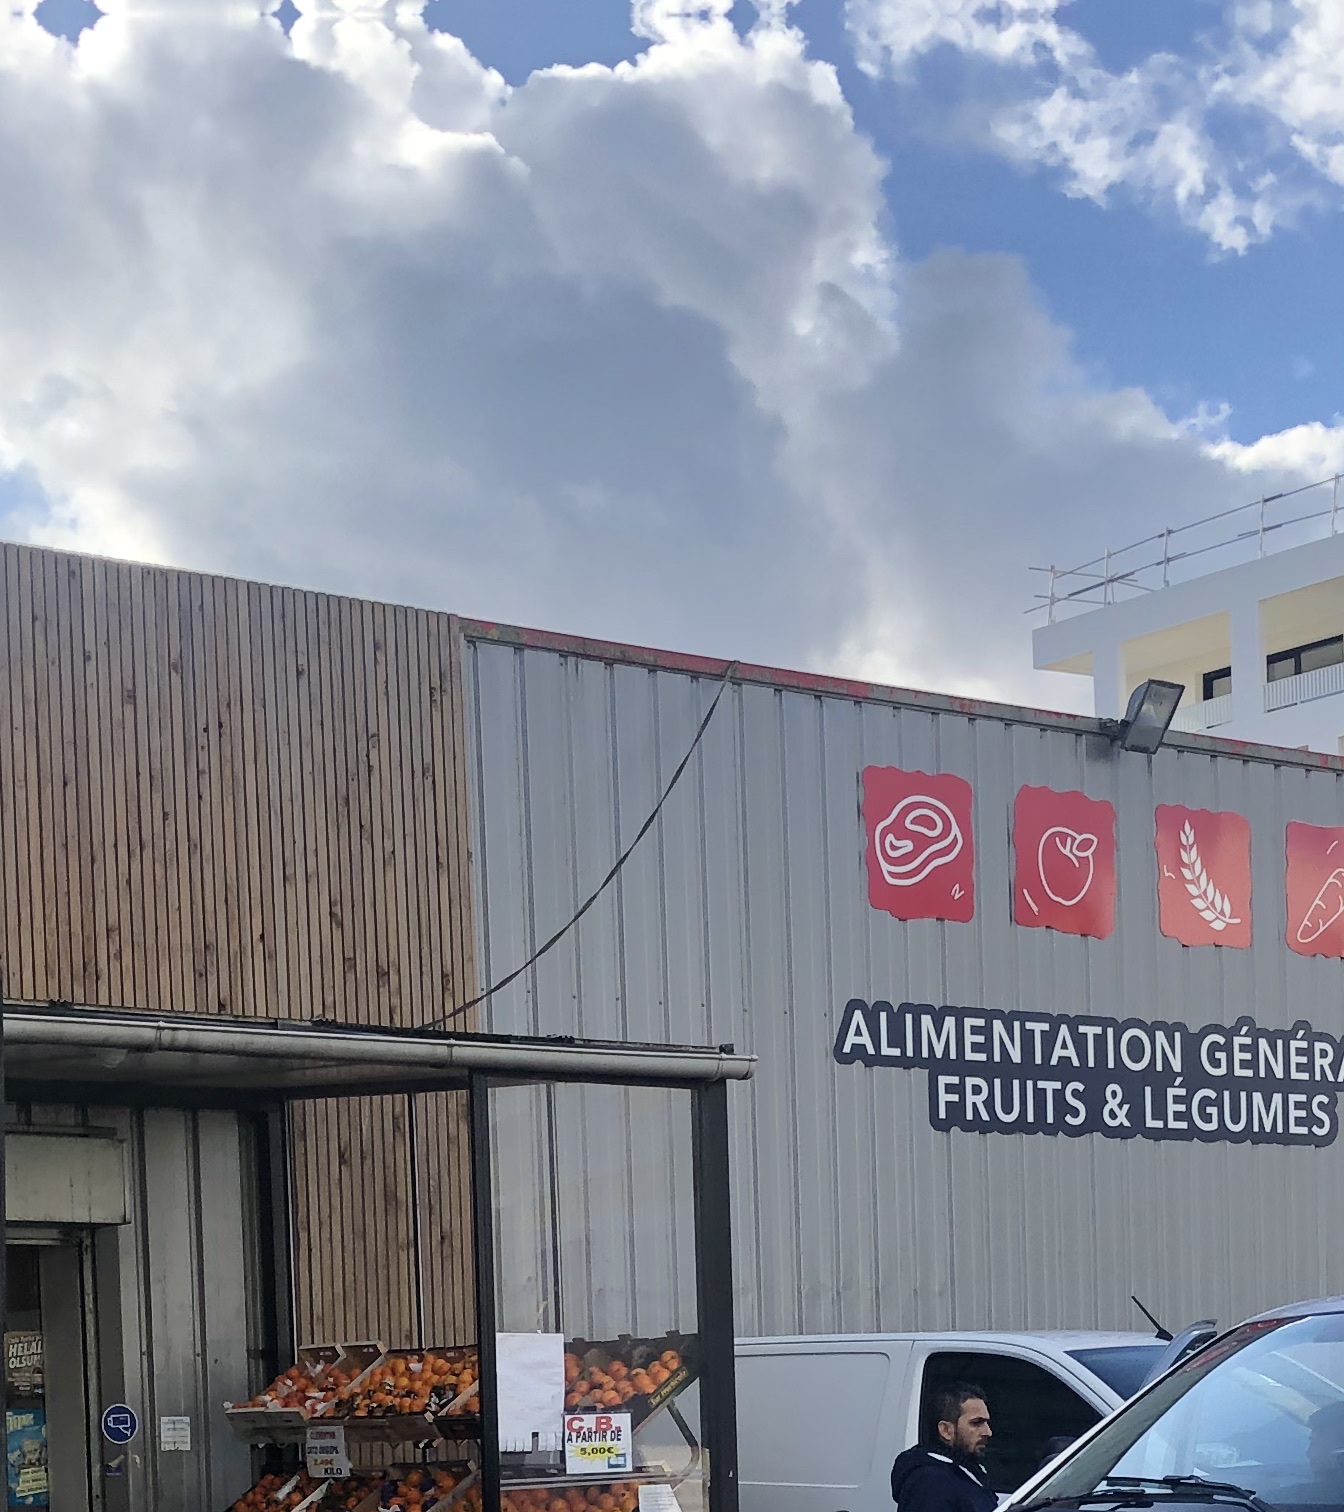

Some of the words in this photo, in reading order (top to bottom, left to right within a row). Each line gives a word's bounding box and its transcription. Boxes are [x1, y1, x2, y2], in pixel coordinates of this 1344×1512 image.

[842, 1009, 1183, 1074] ALIMENTATION
[937, 1074, 1087, 1126] FRUITS
[1102, 1083, 1132, 1128] &
[1144, 1077, 1333, 1137] LÉGUMES
[576, 1430, 607, 1443] PARTIR
[610, 1430, 622, 1442] DE
[580, 1447, 614, 1456] 5,00€
[324, 1468, 343, 1476] KILO
